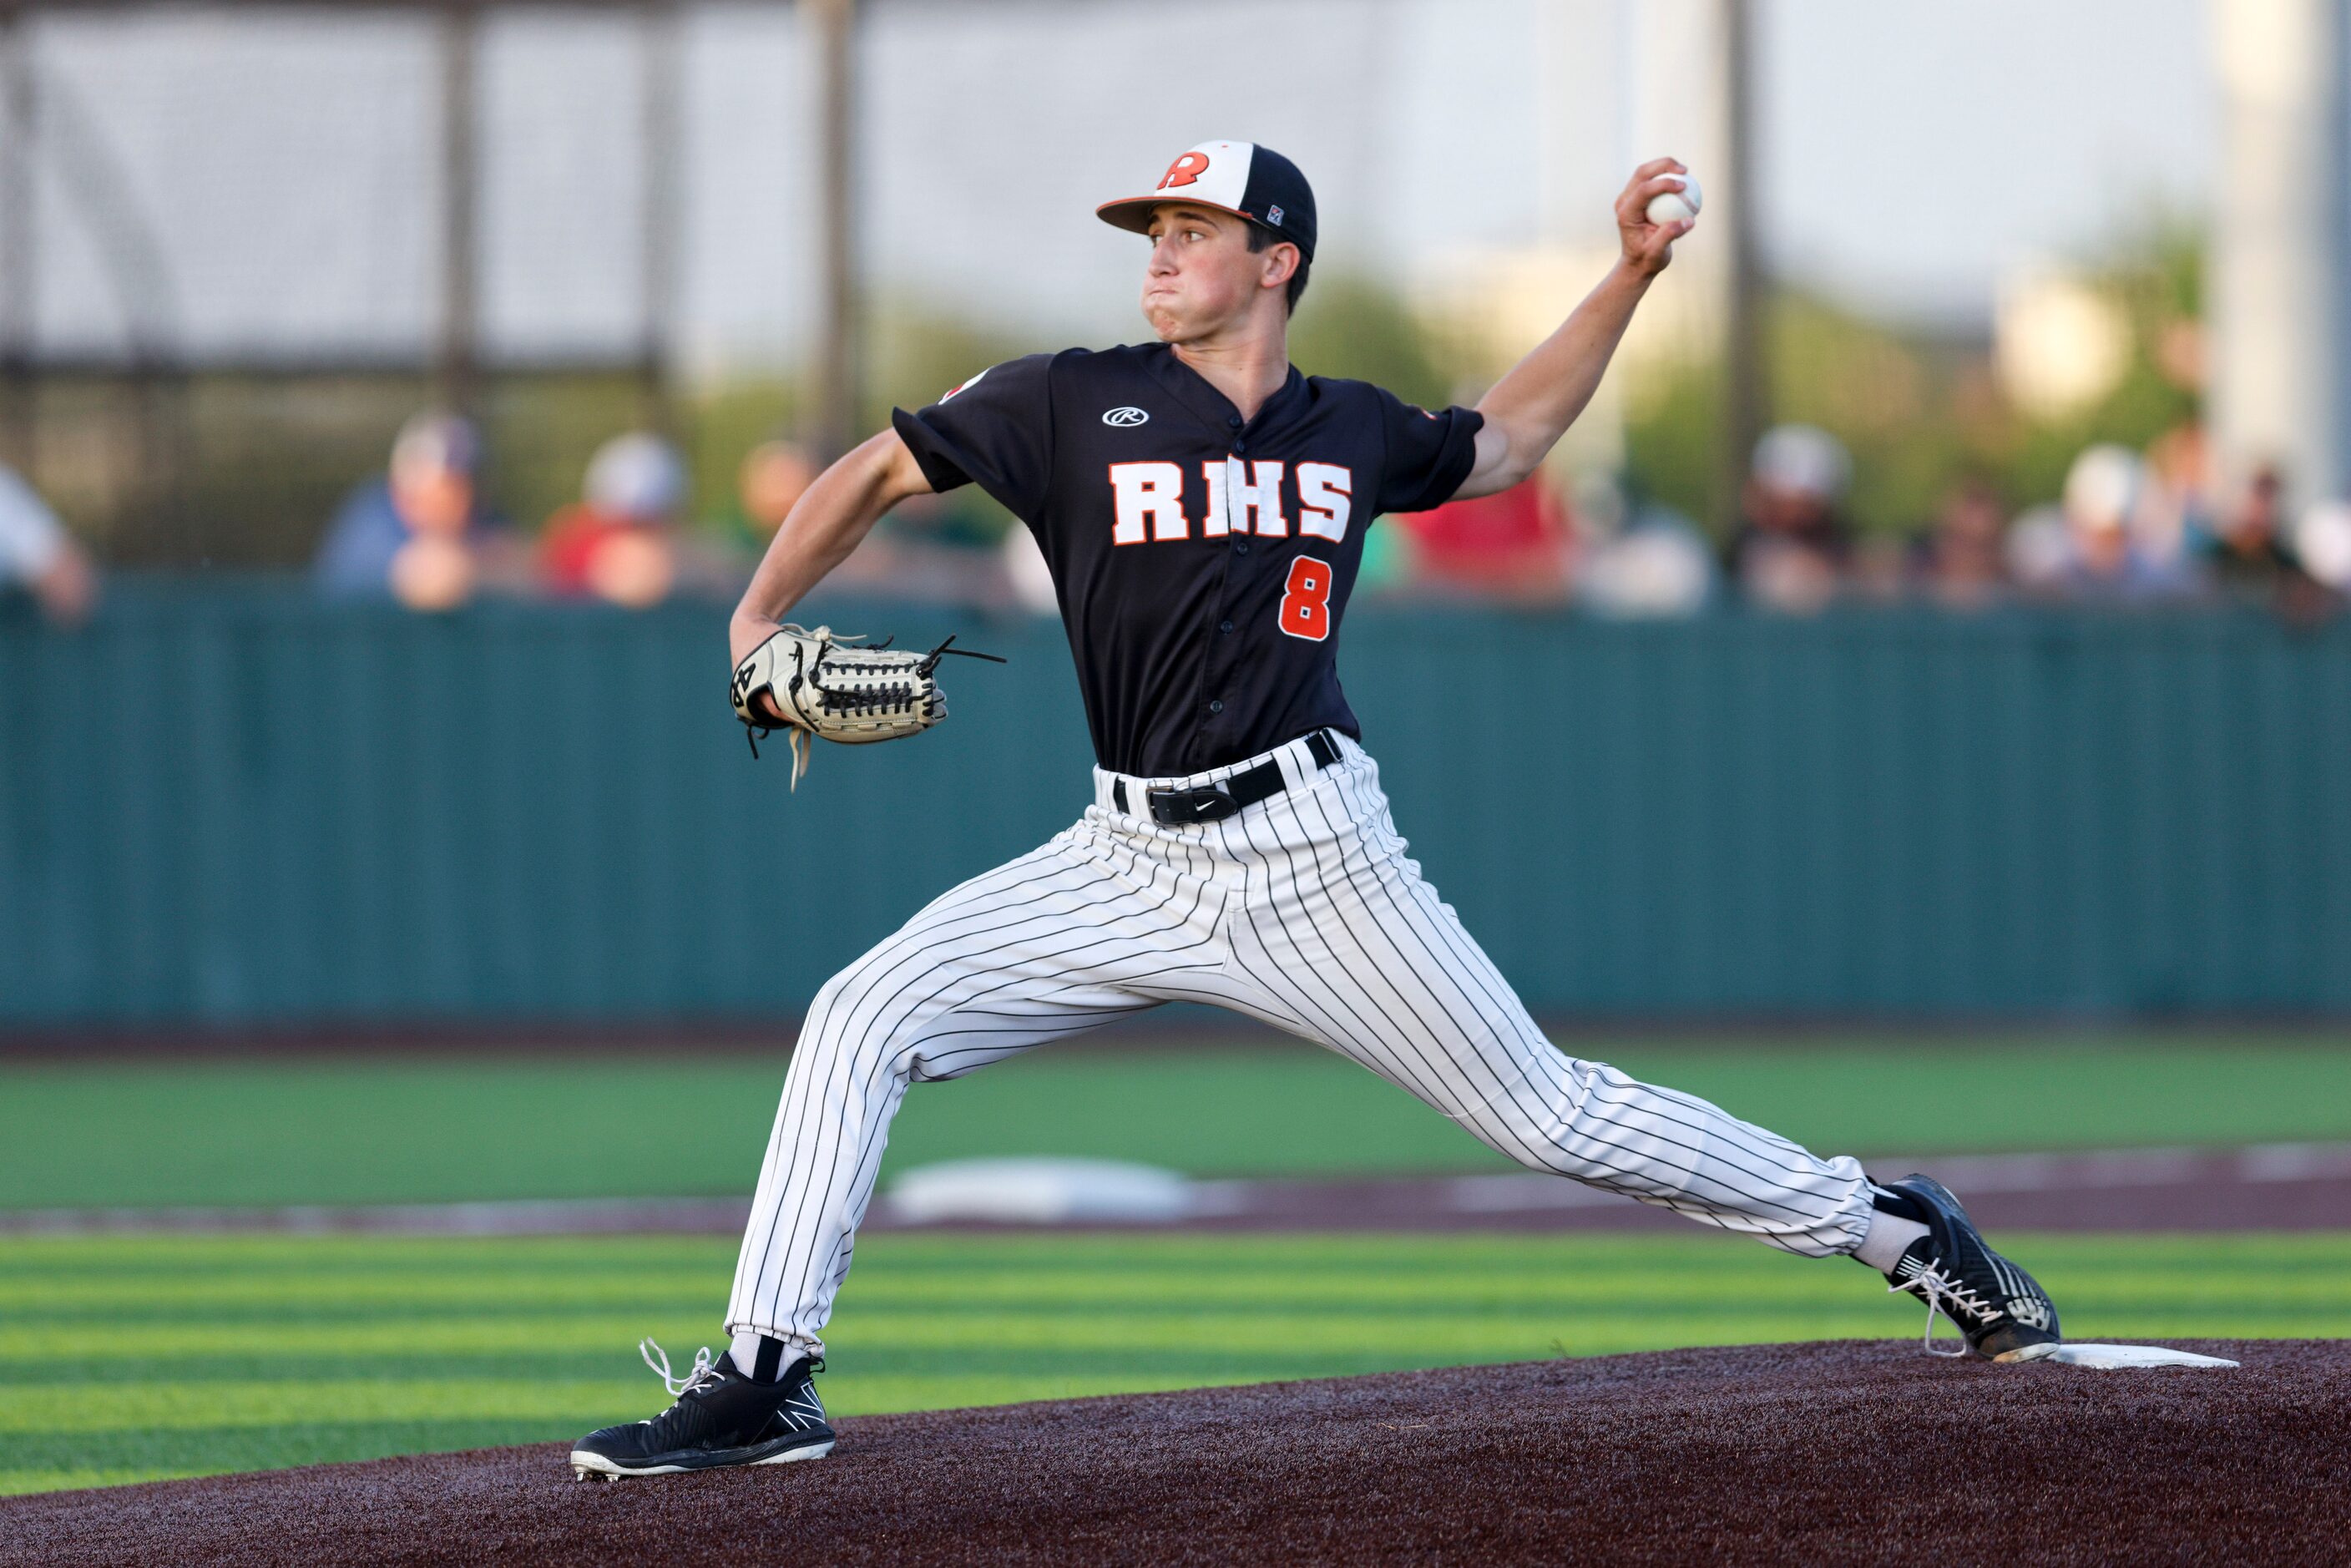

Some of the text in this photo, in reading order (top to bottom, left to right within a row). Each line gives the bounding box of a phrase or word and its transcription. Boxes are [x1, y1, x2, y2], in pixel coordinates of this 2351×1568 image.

[1156, 151, 1210, 190] R
[1109, 453, 1352, 545] RHS
[1278, 554, 1332, 642] 8
